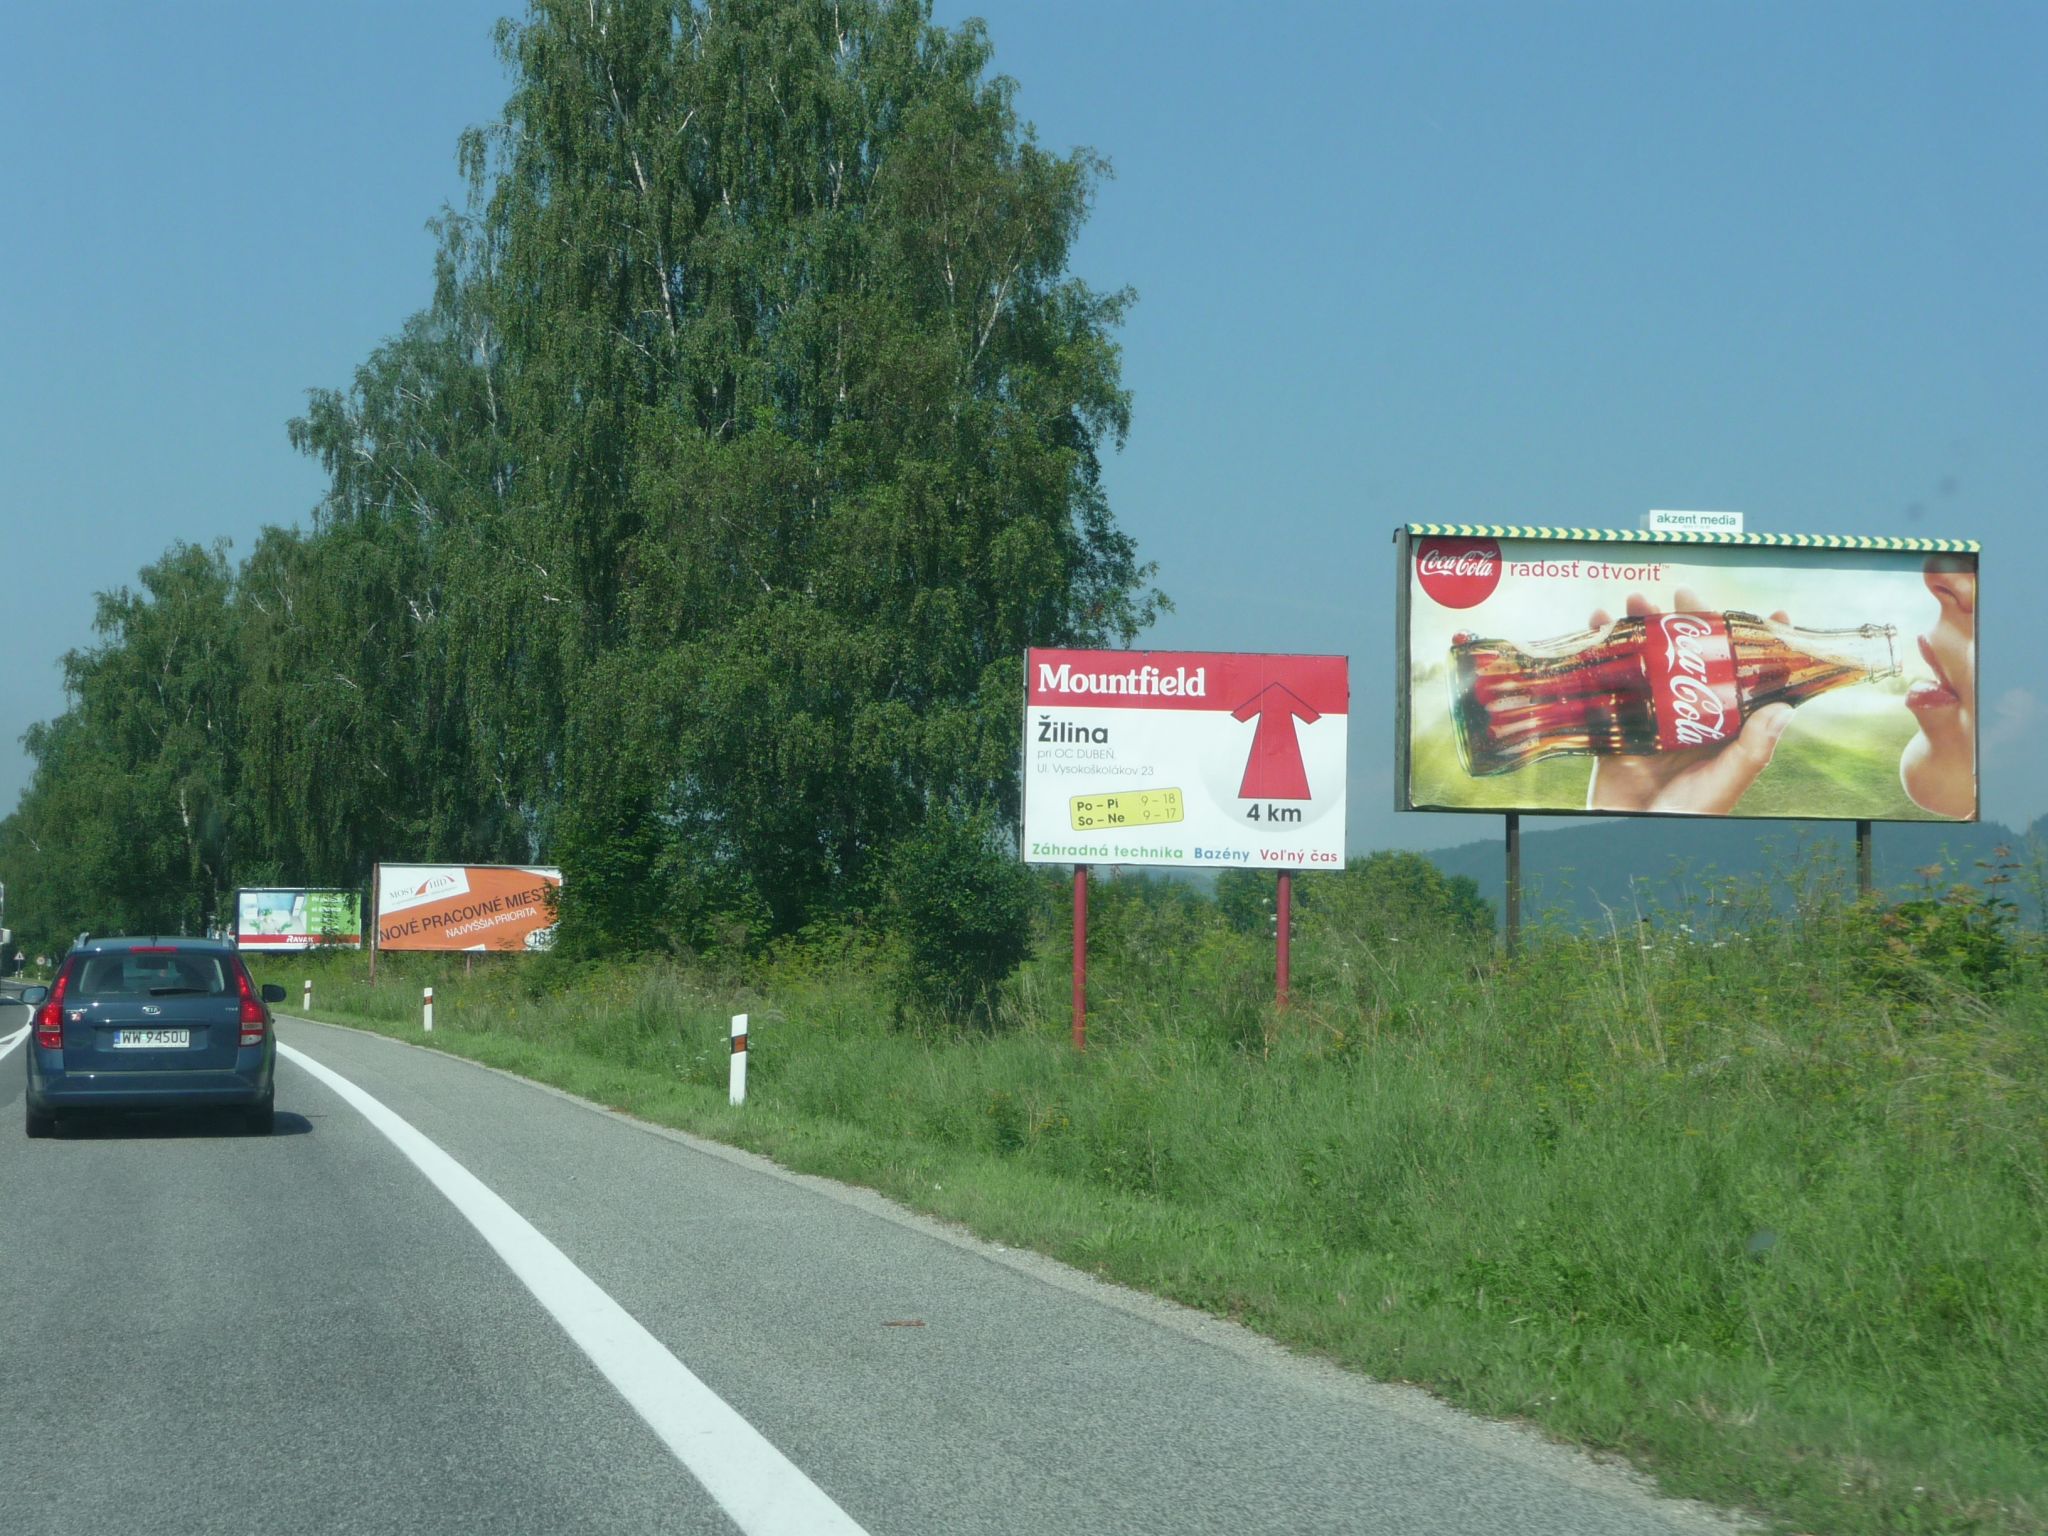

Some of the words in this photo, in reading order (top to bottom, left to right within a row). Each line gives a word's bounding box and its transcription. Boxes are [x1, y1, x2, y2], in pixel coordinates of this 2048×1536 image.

[1656, 513, 1696, 524] akzent
[1700, 515, 1736, 526] media
[1509, 559, 1580, 579] radosť
[1038, 663, 1206, 697] Mountfield
[1038, 714, 1109, 744] Žilina
[1037, 748, 1051, 760] pri
[1054, 748, 1073, 759] OC
[1141, 766, 1154, 776] 23
[1077, 801, 1093, 812] Po
[1107, 798, 1119, 809] Pi
[1141, 795, 1149, 807] 9
[1163, 793, 1176, 805] 18
[1078, 816, 1094, 826] So
[1108, 813, 1125, 824] Ne
[1143, 809, 1151, 820] 9
[1165, 807, 1177, 819] 17
[1246, 803, 1260, 822] 4
[1267, 803, 1303, 823] km
[1032, 843, 1109, 857] Záhradná
[1114, 844, 1184, 859] technika
[1194, 847, 1251, 863] Bazény
[1260, 849, 1305, 864] Voľný
[1310, 849, 1338, 863] čas
[380, 918, 420, 942] NOVÉ
[422, 896, 504, 931] PRACOVNÉ
[495, 907, 537, 924] PRIORITA
[122, 1031, 141, 1044] WW
[146, 1030, 188, 1044] 9450U
